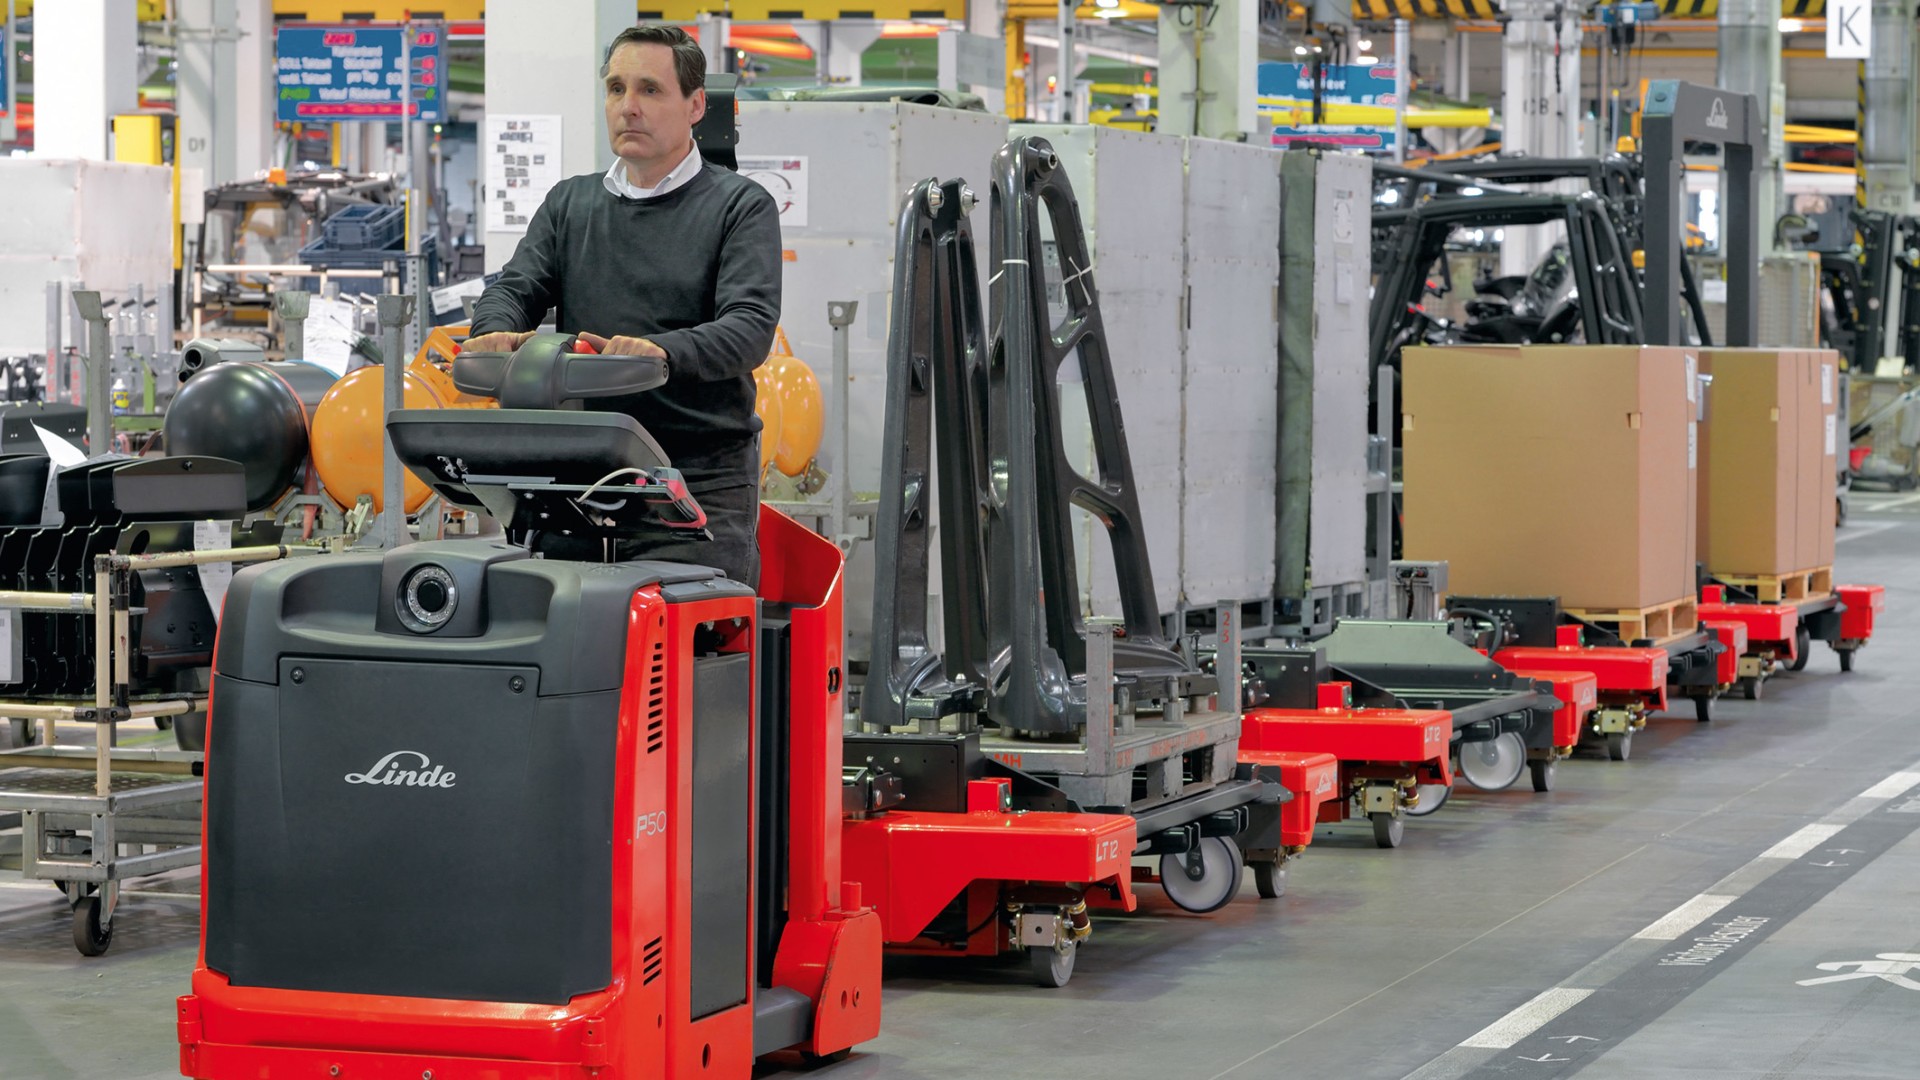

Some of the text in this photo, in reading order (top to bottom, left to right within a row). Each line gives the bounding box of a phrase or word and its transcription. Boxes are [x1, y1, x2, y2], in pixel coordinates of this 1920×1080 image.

[1839, 6, 1862, 46] K
[344, 750, 456, 788] Linde
[635, 810, 668, 840] P50
[1657, 915, 1771, 966] Visitors Besucher
